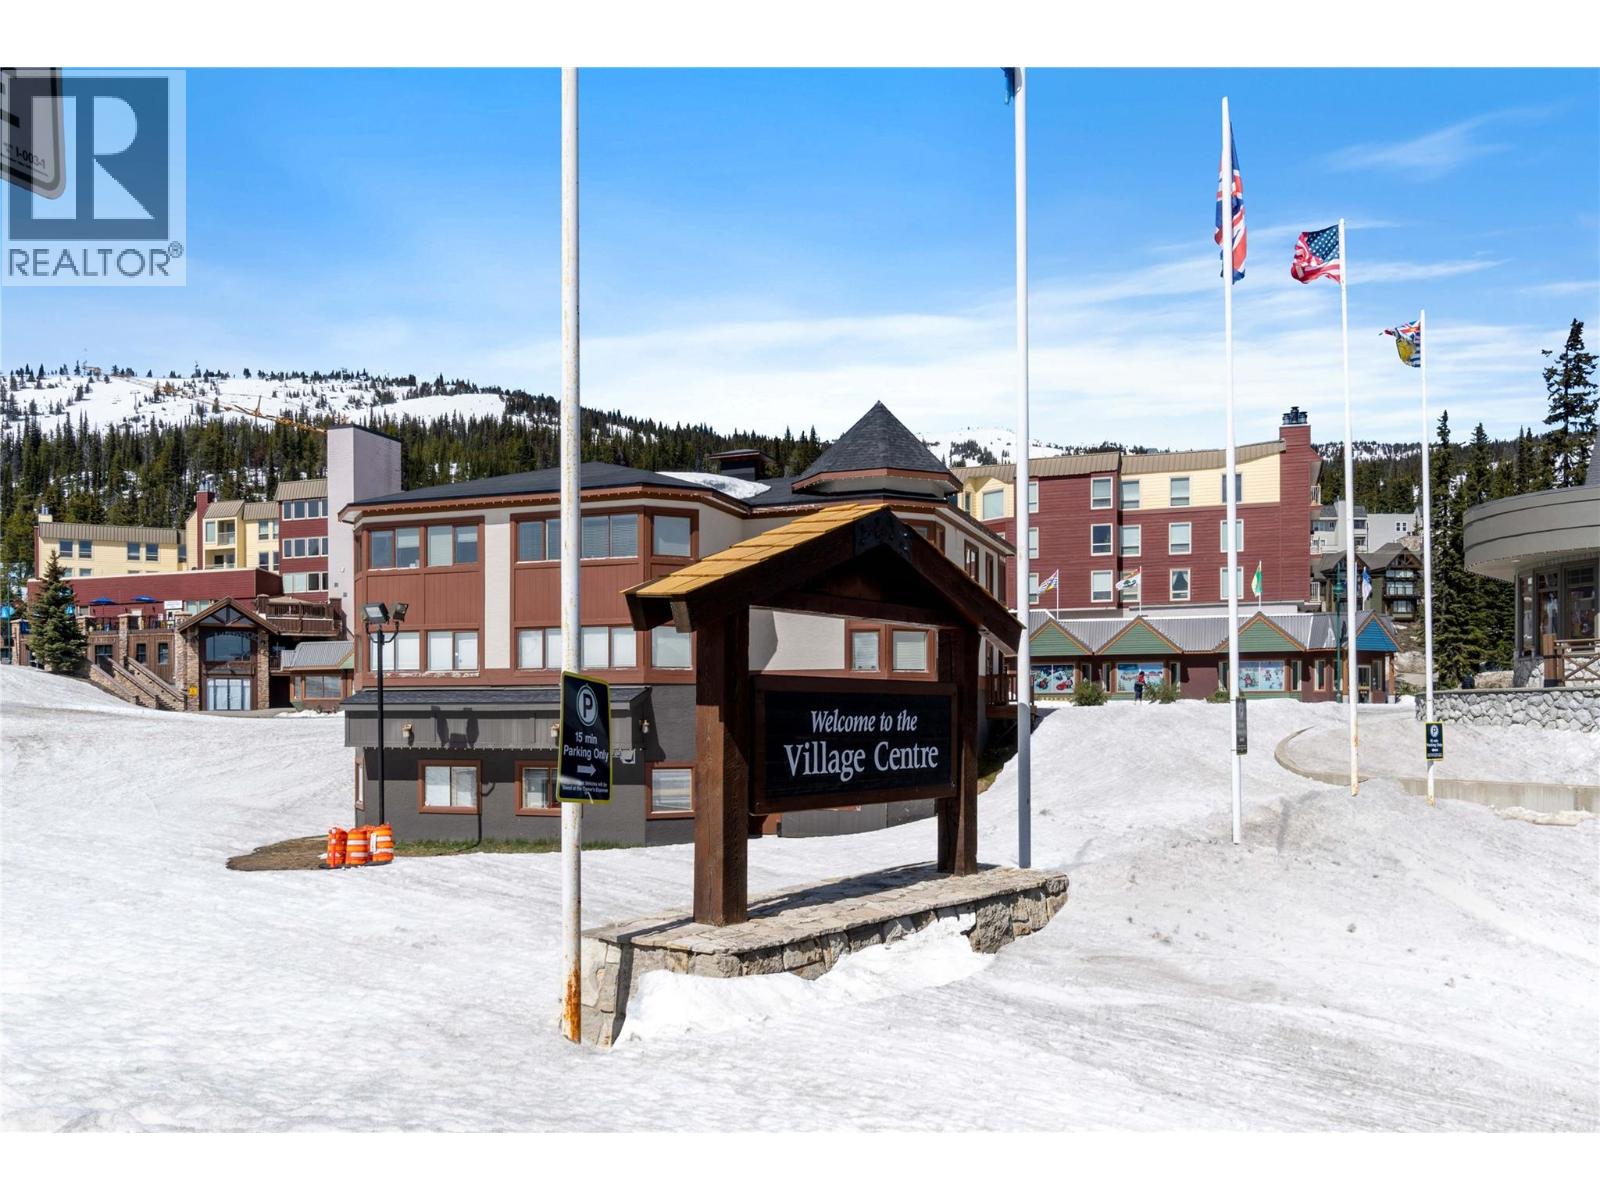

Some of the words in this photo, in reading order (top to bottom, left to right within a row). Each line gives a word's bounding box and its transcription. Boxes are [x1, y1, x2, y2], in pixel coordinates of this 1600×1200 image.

[811, 709, 875, 733] Welcome
[880, 712, 893, 732] to
[897, 709, 918, 732] the
[575, 732, 583, 742] 15
[585, 733, 598, 744] min
[563, 745, 592, 760] Parking
[594, 748, 609, 762] Only
[784, 741, 866, 782] Village
[874, 741, 939, 772] Centre
